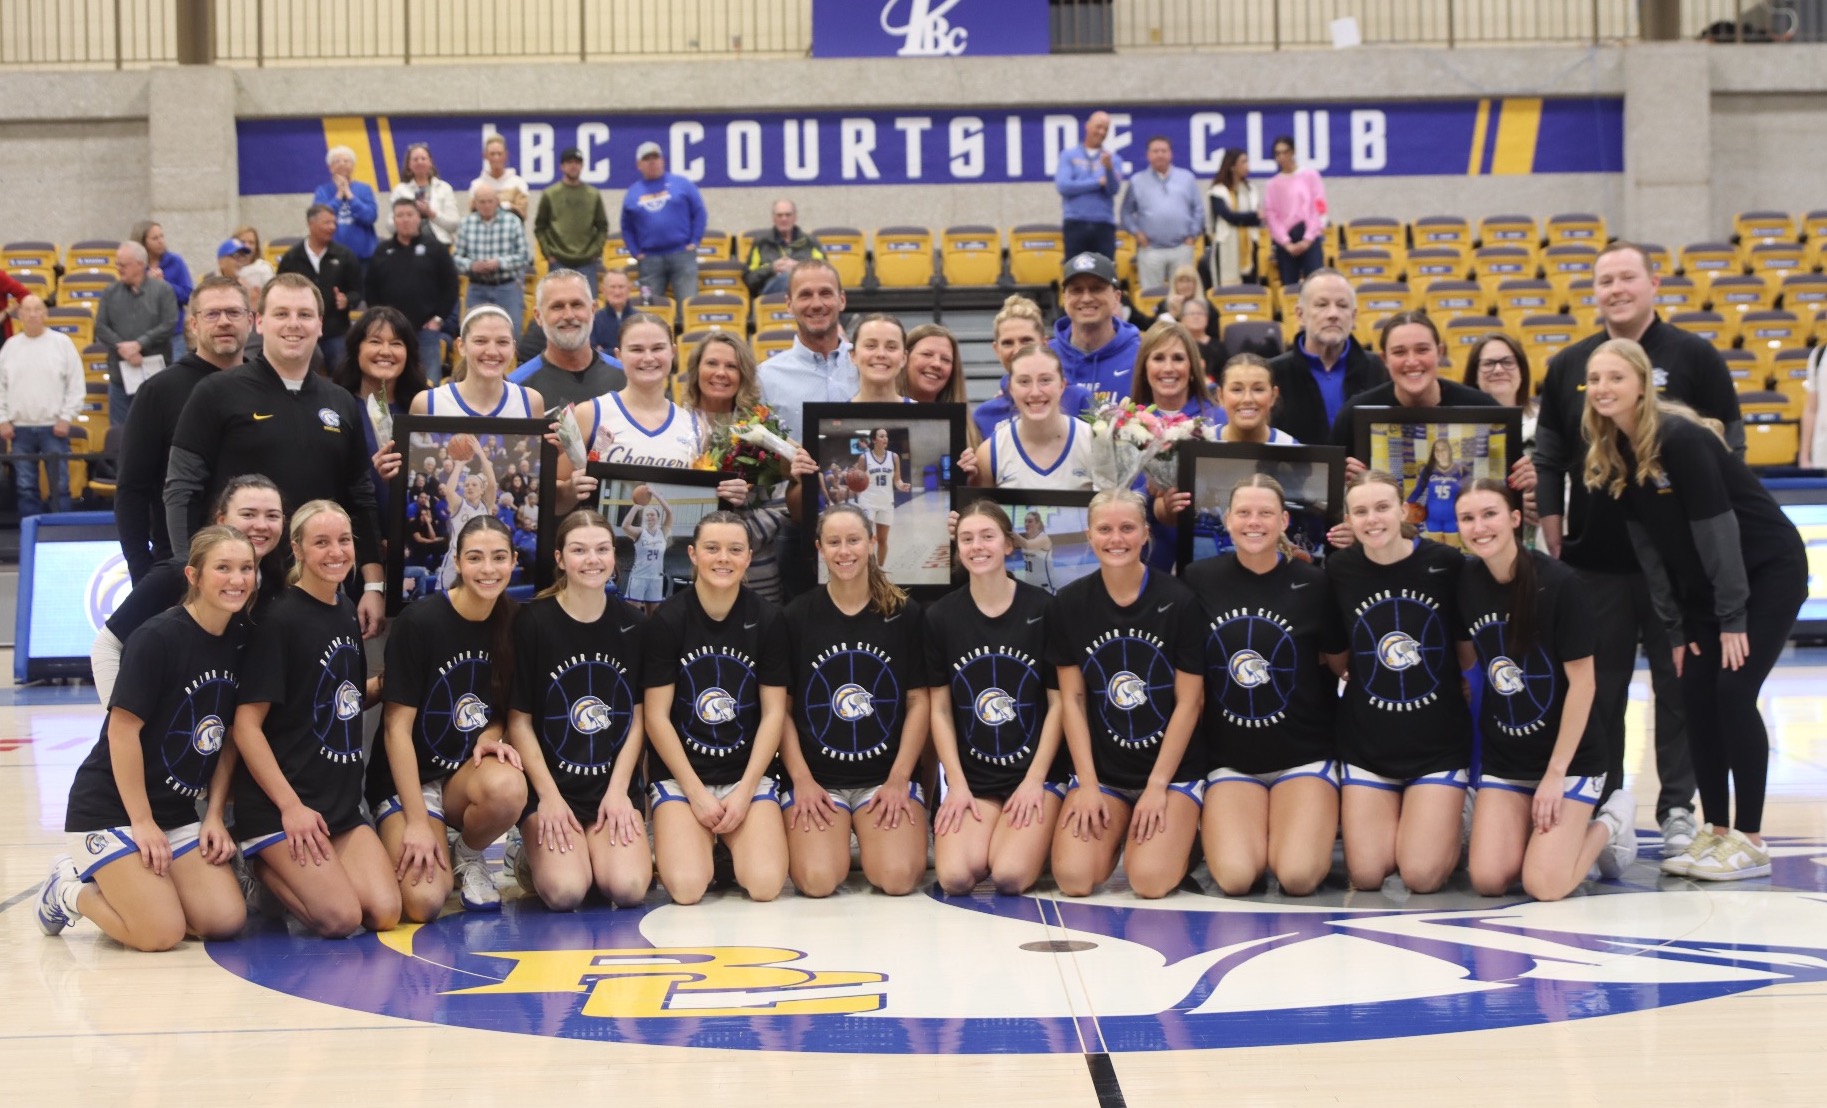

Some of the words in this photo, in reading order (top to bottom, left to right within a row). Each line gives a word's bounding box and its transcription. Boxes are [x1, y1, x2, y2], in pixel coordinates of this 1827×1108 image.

[669, 113, 1134, 183] COURTSIDE
[1190, 109, 1388, 175] CLUB
[876, 474, 887, 487] 15
[1434, 485, 1451, 499] 45
[647, 549, 659, 561] 24
[1355, 589, 1392, 617] BRIAR
[1401, 588, 1440, 610] CLIFF
[1209, 607, 1249, 631] BRIAR
[1257, 607, 1294, 632] CLIFF
[1085, 628, 1120, 655] BRIAR
[1129, 627, 1164, 648] CLIFF
[439, 650, 472, 676] BRIAR
[549, 653, 586, 681] BRIAR
[595, 652, 627, 675] CLIFF
[722, 646, 756, 668] CLIFF
[811, 642, 848, 670] BRIAR
[857, 641, 892, 663] CLIFF
[953, 645, 990, 672] BRIAR
[999, 645, 1036, 667] CLIFF
[184, 669, 217, 695] BRIAR
[1368, 692, 1438, 712] CHARGERS
[1222, 708, 1286, 728] CHARGERS
[821, 742, 888, 762] CHARGERS
[558, 760, 611, 776] CHARGE
